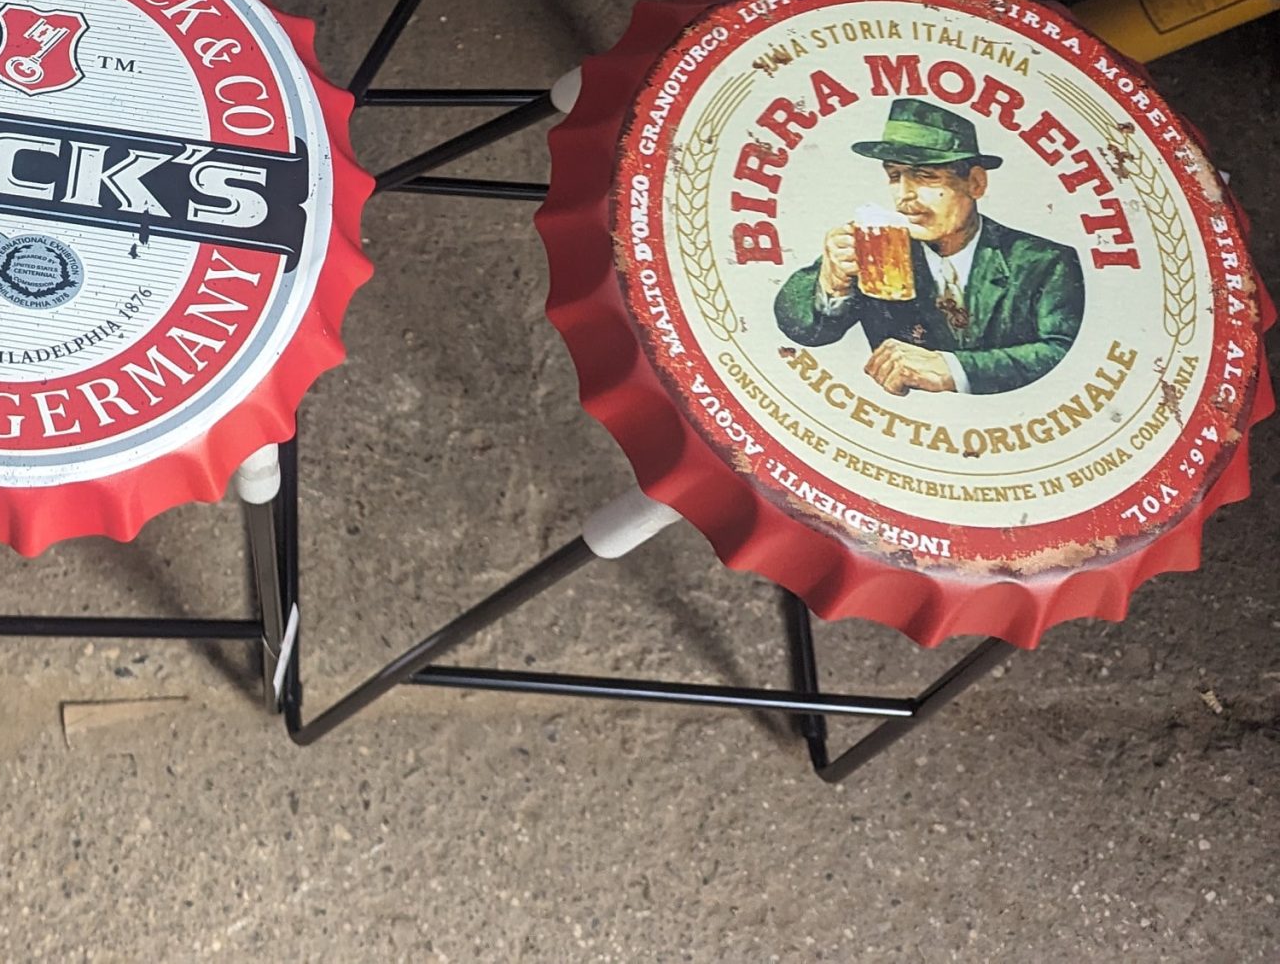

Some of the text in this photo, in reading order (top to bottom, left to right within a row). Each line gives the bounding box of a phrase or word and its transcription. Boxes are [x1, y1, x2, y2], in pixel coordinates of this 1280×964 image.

[96, 54, 143, 76] TM.
[194, 36, 242, 70] &
[811, 19, 903, 49] STORIA
[912, 21, 1030, 77] ITALIANA
[214, 74, 276, 137] CO
[638, 26, 729, 156] GRANOTURCO
[730, 54, 1142, 270] BIRRA MORETTI
[49, 240, 80, 276] EXHIBITION
[119, 286, 153, 321] 1876
[639, 269, 686, 357] MALTO
[690, 373, 765, 456] ACQUA
[718, 351, 1200, 503] CONSUMARE PREFERIBILMENTE IN BUONA COMPGNIA
[787, 340, 1139, 458] RICETTA ORIGINALE
[1120, 483, 1180, 524] VOL.
